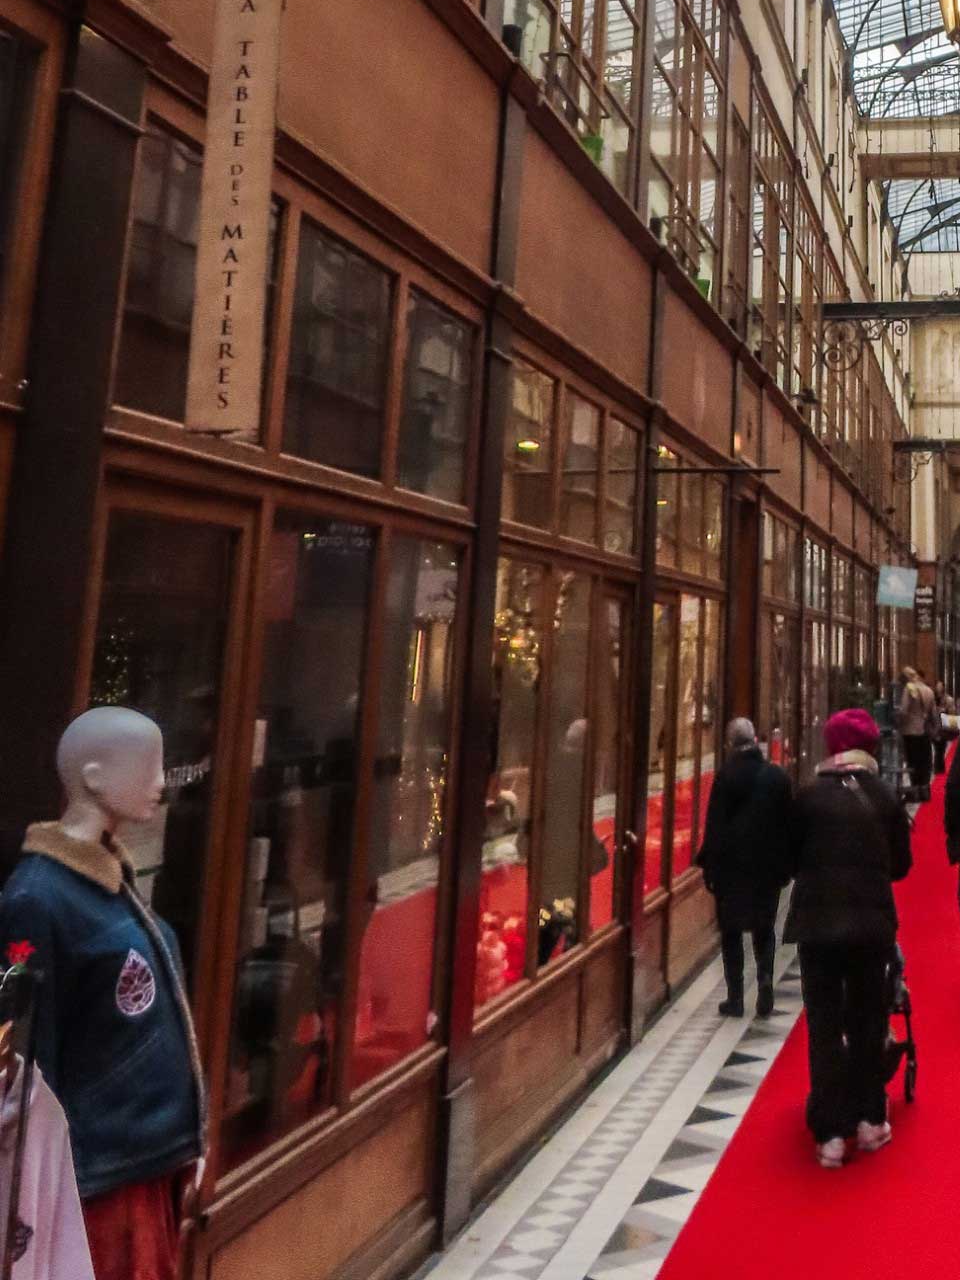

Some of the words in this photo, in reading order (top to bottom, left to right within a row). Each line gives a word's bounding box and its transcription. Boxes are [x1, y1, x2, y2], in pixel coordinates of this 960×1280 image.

[233, 40, 254, 147] TABLE
[230, 164, 244, 206] DES
[216, 223, 243, 409] MATIÈRES
